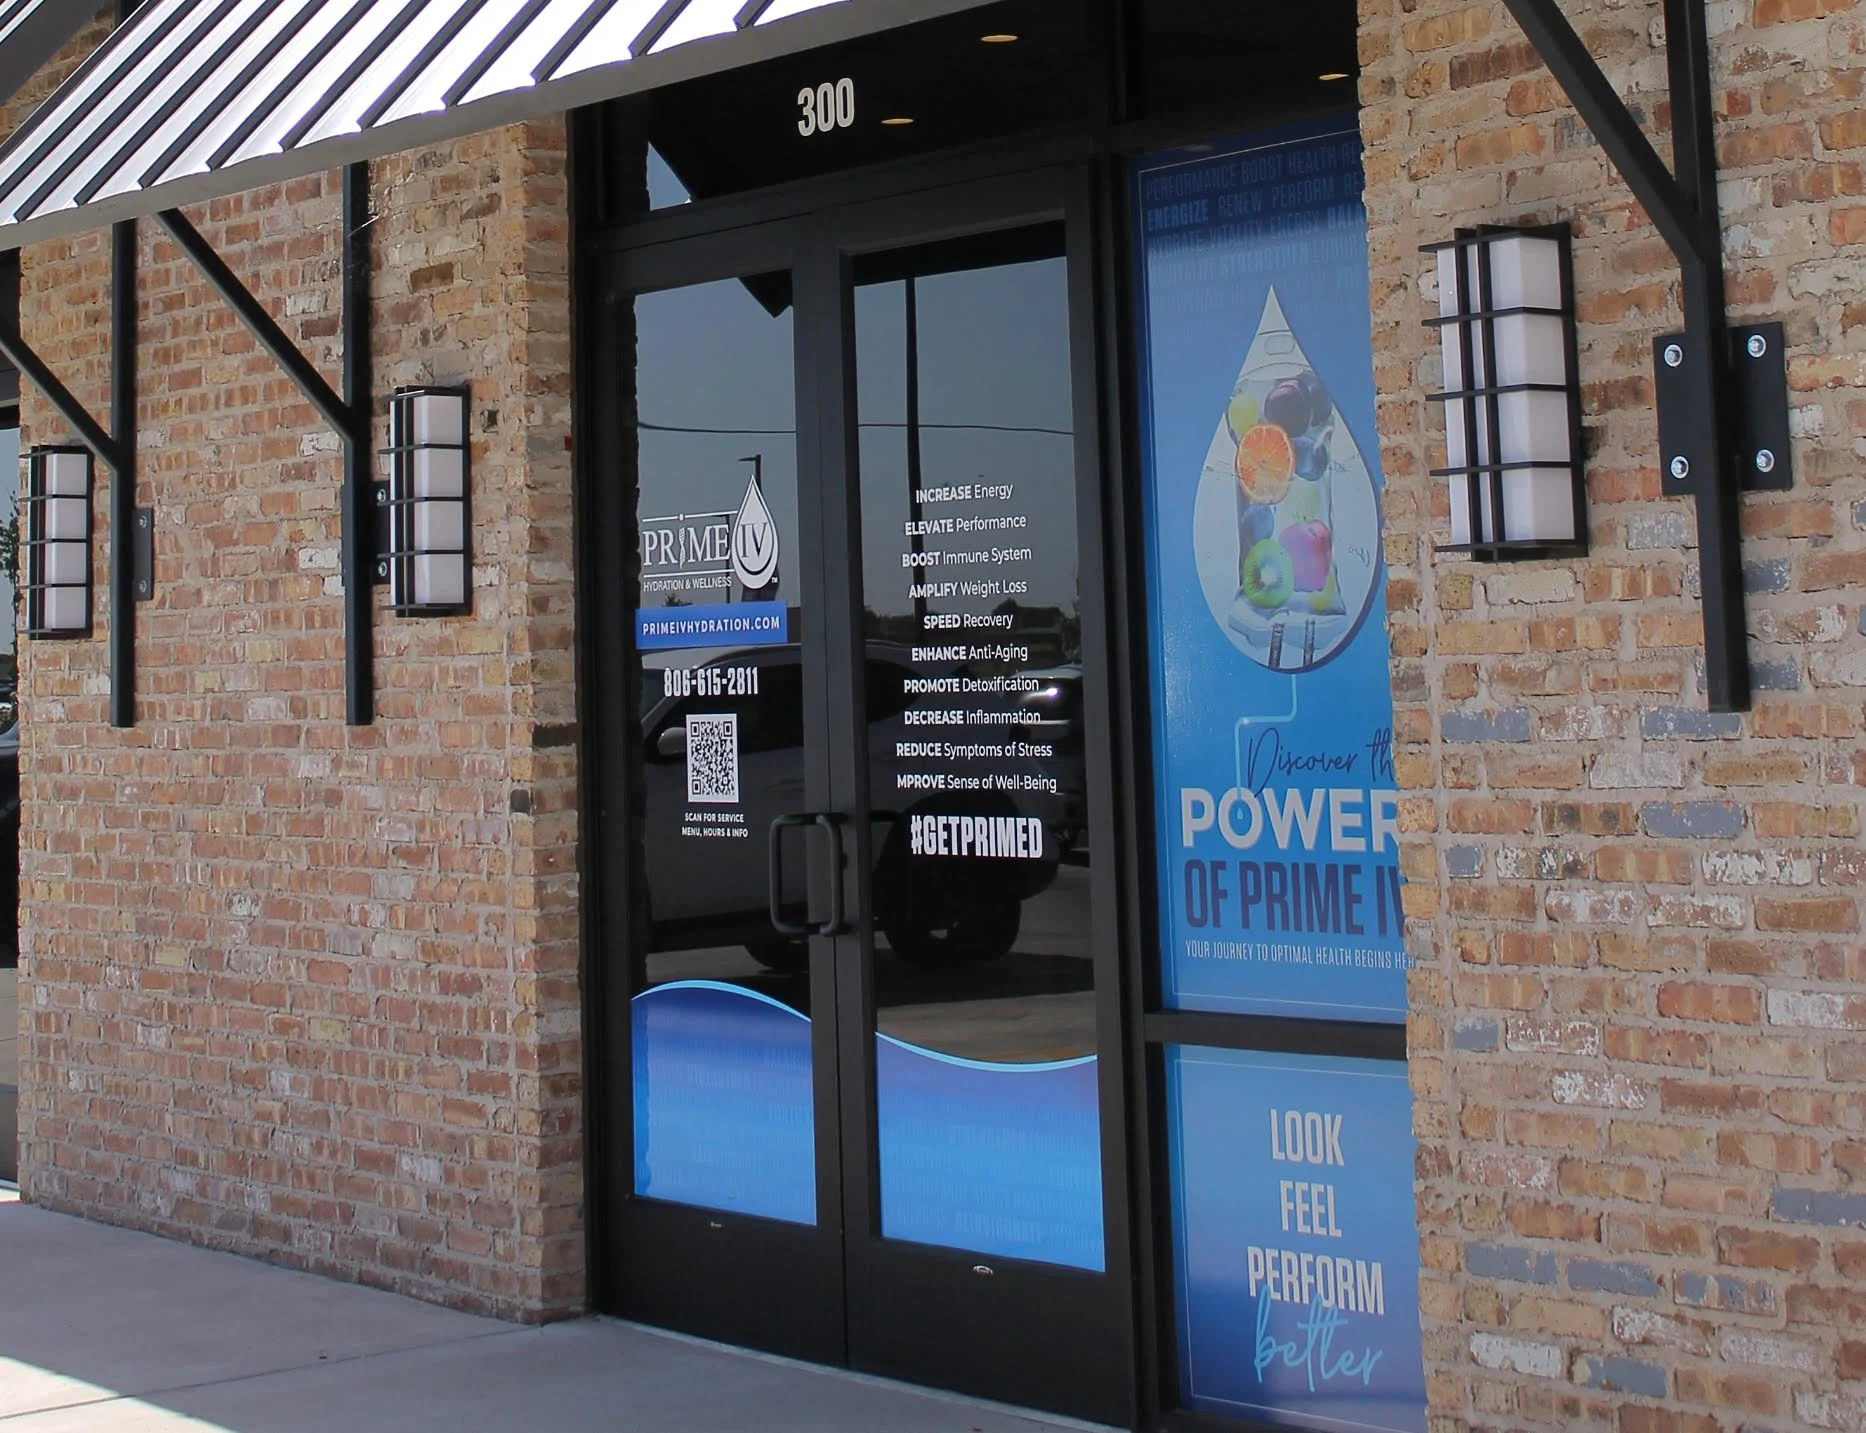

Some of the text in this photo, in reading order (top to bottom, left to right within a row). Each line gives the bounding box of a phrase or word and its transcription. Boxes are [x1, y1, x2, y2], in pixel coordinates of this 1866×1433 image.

[797, 78, 855, 137] 300
[916, 484, 1014, 503] INCREASE Energy
[904, 515, 1027, 536] ELEVATE Performance
[642, 520, 768, 569] PRIME IV
[902, 547, 1032, 567] BOOST Immune System
[643, 579, 684, 592] HYDRATION
[685, 579, 693, 590] &
[696, 576, 732, 589] WELLNESS
[908, 579, 1028, 599] AMPLIFY Weight Loss
[642, 616, 780, 635] PRIMEIVHYDRATION.COM
[923, 613, 1014, 630] SPEED Recovery
[911, 643, 1028, 662] ENHANCE Anti-Aging
[664, 667, 759, 697] 806-615-2811
[903, 676, 1039, 693] PROMOTE Detoxification
[904, 708, 1041, 725] DECREASE Inflammation
[896, 742, 1053, 760] REDUCE Symptoms of Stress
[1247, 727, 1394, 798] Discover th
[897, 774, 1057, 794] MPROVE Sense of Well-Being
[684, 812, 745, 823] SCAN FOR SERVICE
[1180, 786, 1400, 853] POWER
[681, 826, 702, 837] MENU,
[703, 827, 725, 837] HOURS
[732, 828, 748, 838] INFO
[911, 815, 1043, 859] #GETPRIMED
[1184, 859, 1228, 928] OF
[1239, 861, 1364, 936] PRIME
[1185, 940, 1210, 959] YOUR
[1213, 942, 1253, 961] JOURNEY
[1256, 943, 1268, 961] TO
[1271, 945, 1313, 964] OPTIMAL
[1316, 948, 1352, 966] HEALTH
[1354, 949, 1392, 969] BEGINS
[1270, 1108, 1345, 1166] LOOK
[1279, 1179, 1342, 1238] FEEL
[1247, 1246, 1386, 1315] PERFORM
[1254, 1285, 1384, 1393] better
